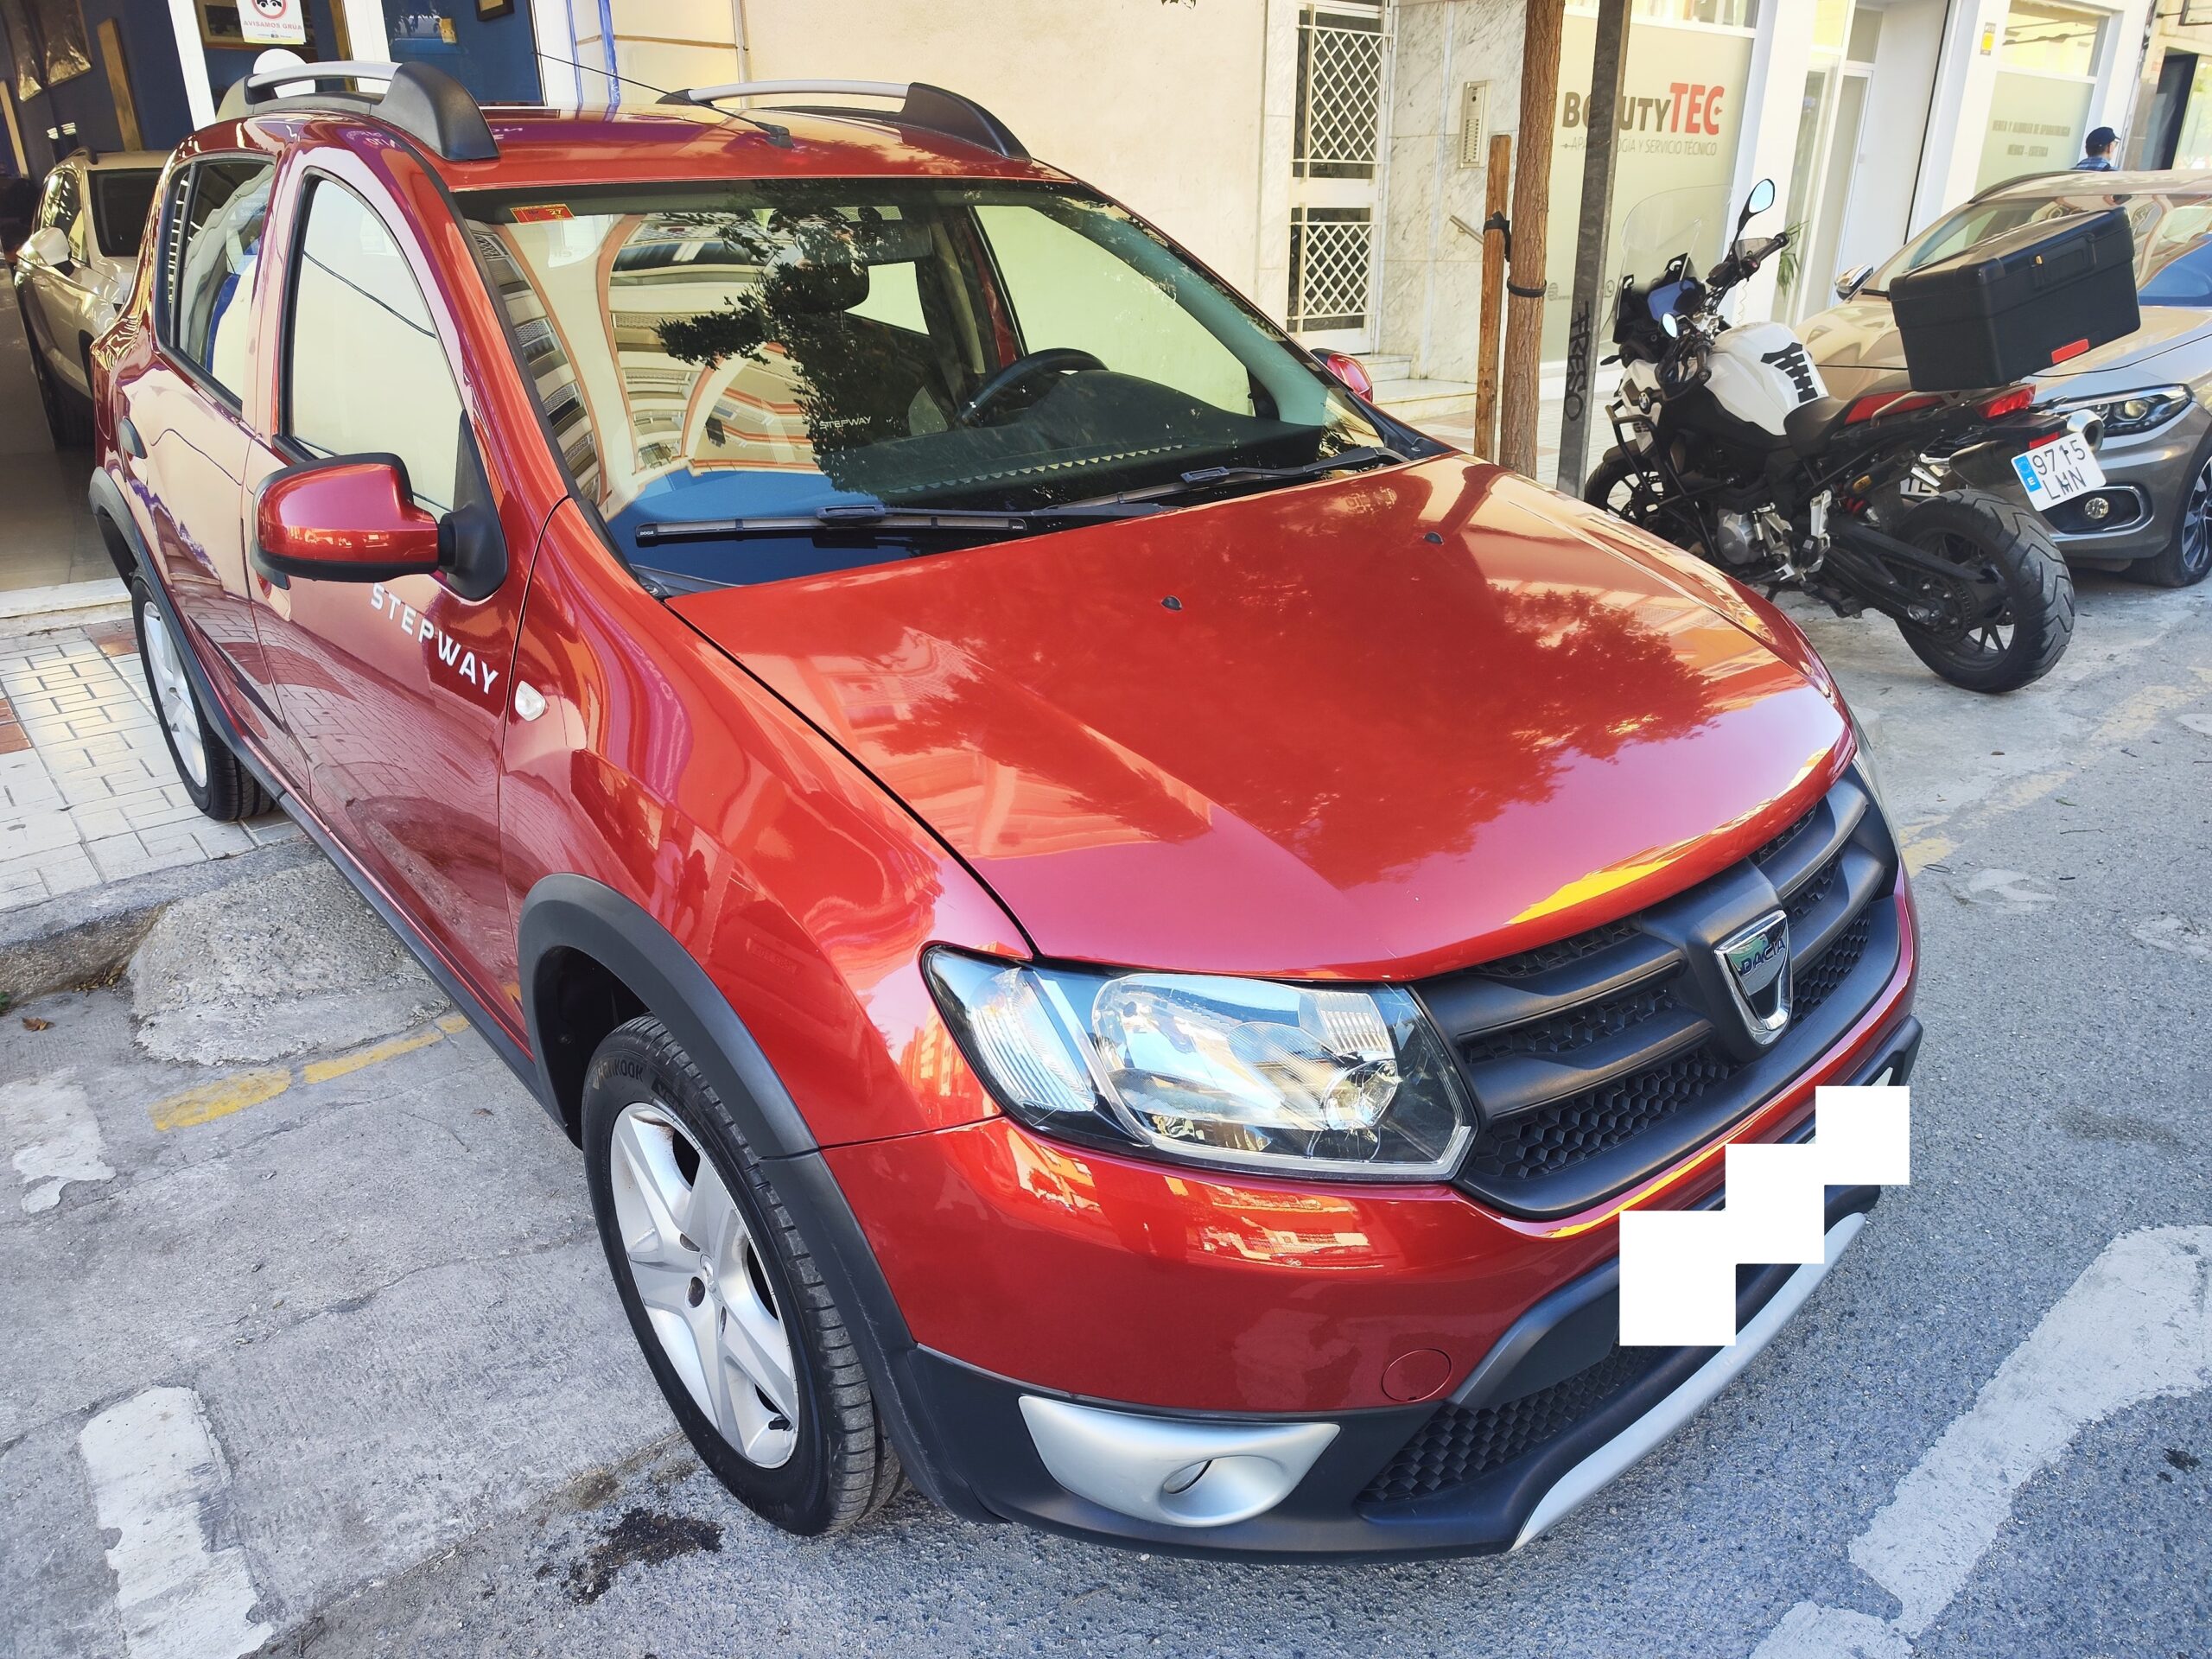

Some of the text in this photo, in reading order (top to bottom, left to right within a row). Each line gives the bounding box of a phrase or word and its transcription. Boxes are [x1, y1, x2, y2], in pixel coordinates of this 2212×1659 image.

[243, 20, 281, 29] AVISAMOS
[1562, 83, 1725, 135] BUTYTEC
[1637, 139, 1643, 153] Y
[1645, 138, 1681, 155] SERVICIO
[818, 416, 871, 431] STEPWAY
[2031, 439, 2086, 475] 9715
[2042, 467, 2087, 500] LMN
[371, 582, 499, 695] STEPWAY
[1740, 938, 1786, 976] DACIA
